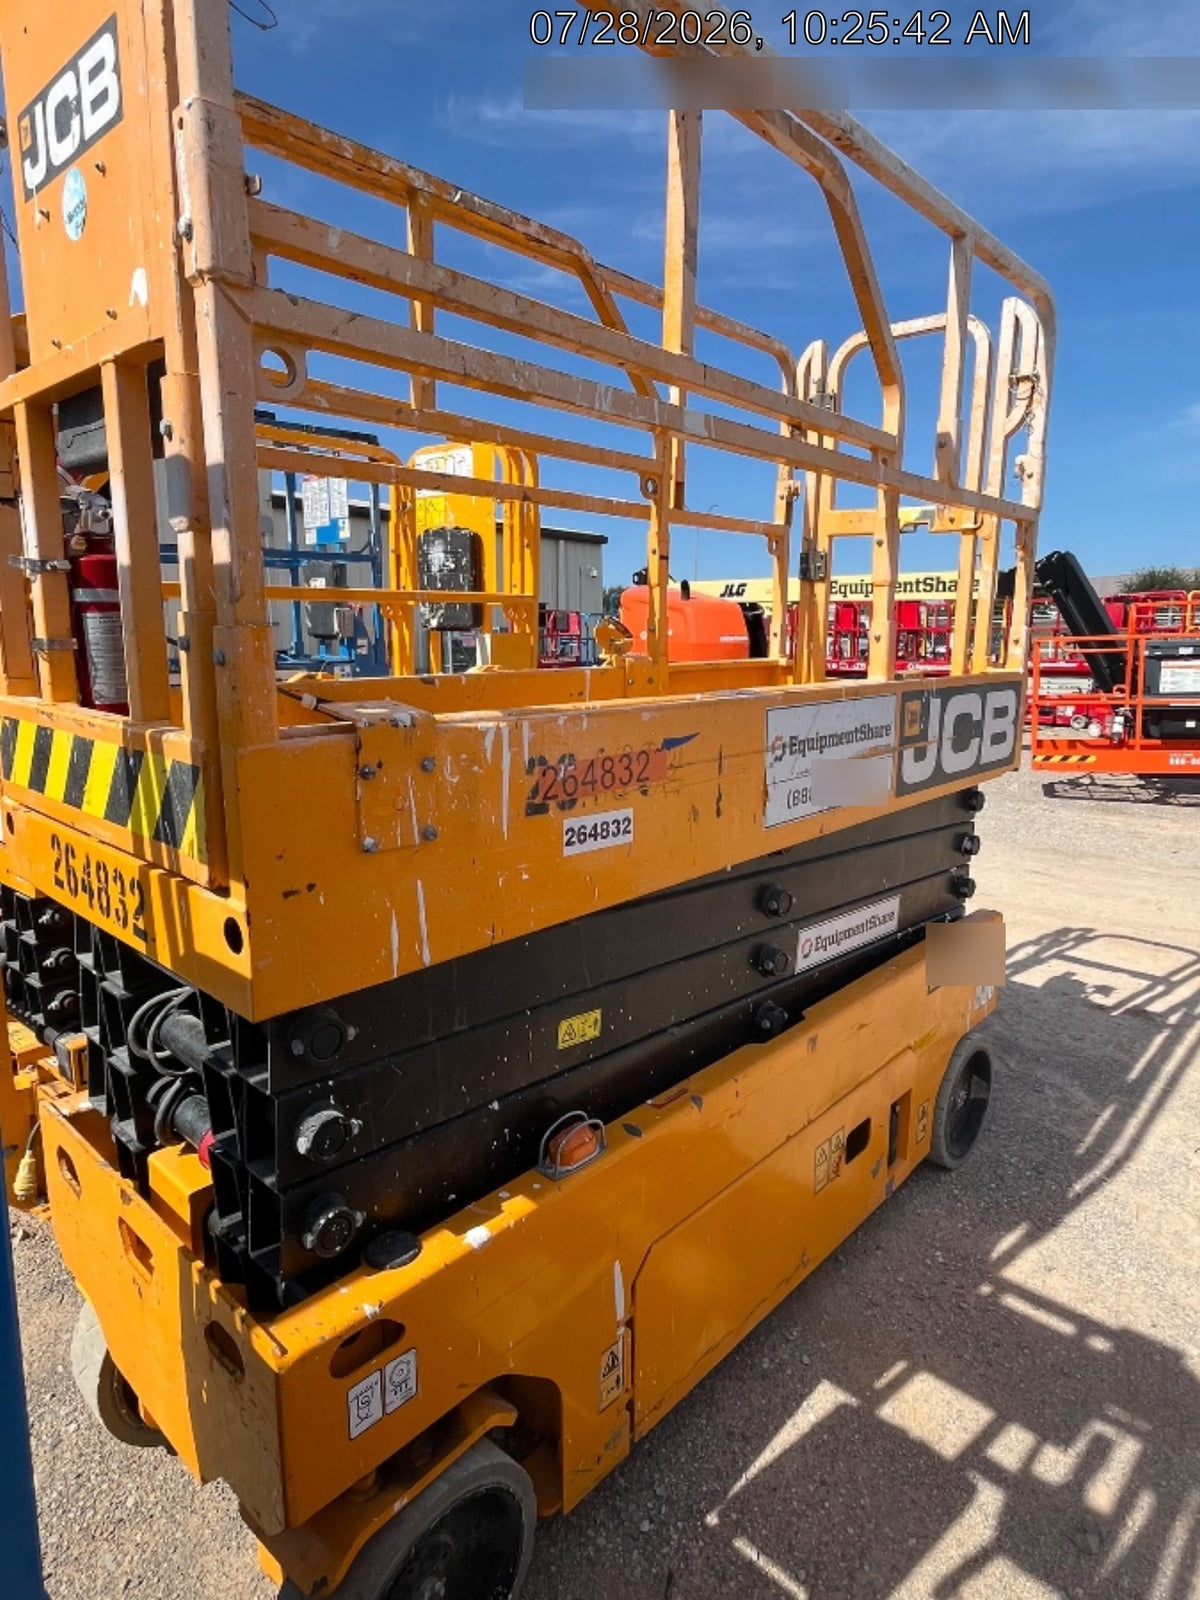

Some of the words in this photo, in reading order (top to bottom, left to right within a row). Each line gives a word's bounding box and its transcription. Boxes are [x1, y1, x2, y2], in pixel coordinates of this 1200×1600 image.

[23, 32, 120, 189] JCB
[719, 583, 748, 597] JLG
[789, 723, 892, 758] EquipmentShare
[901, 689, 1017, 785] JCB
[541, 750, 650, 801] 264832
[564, 816, 632, 847] 264832
[51, 833, 148, 943] 264832
[815, 910, 896, 949] EquipmentShare
